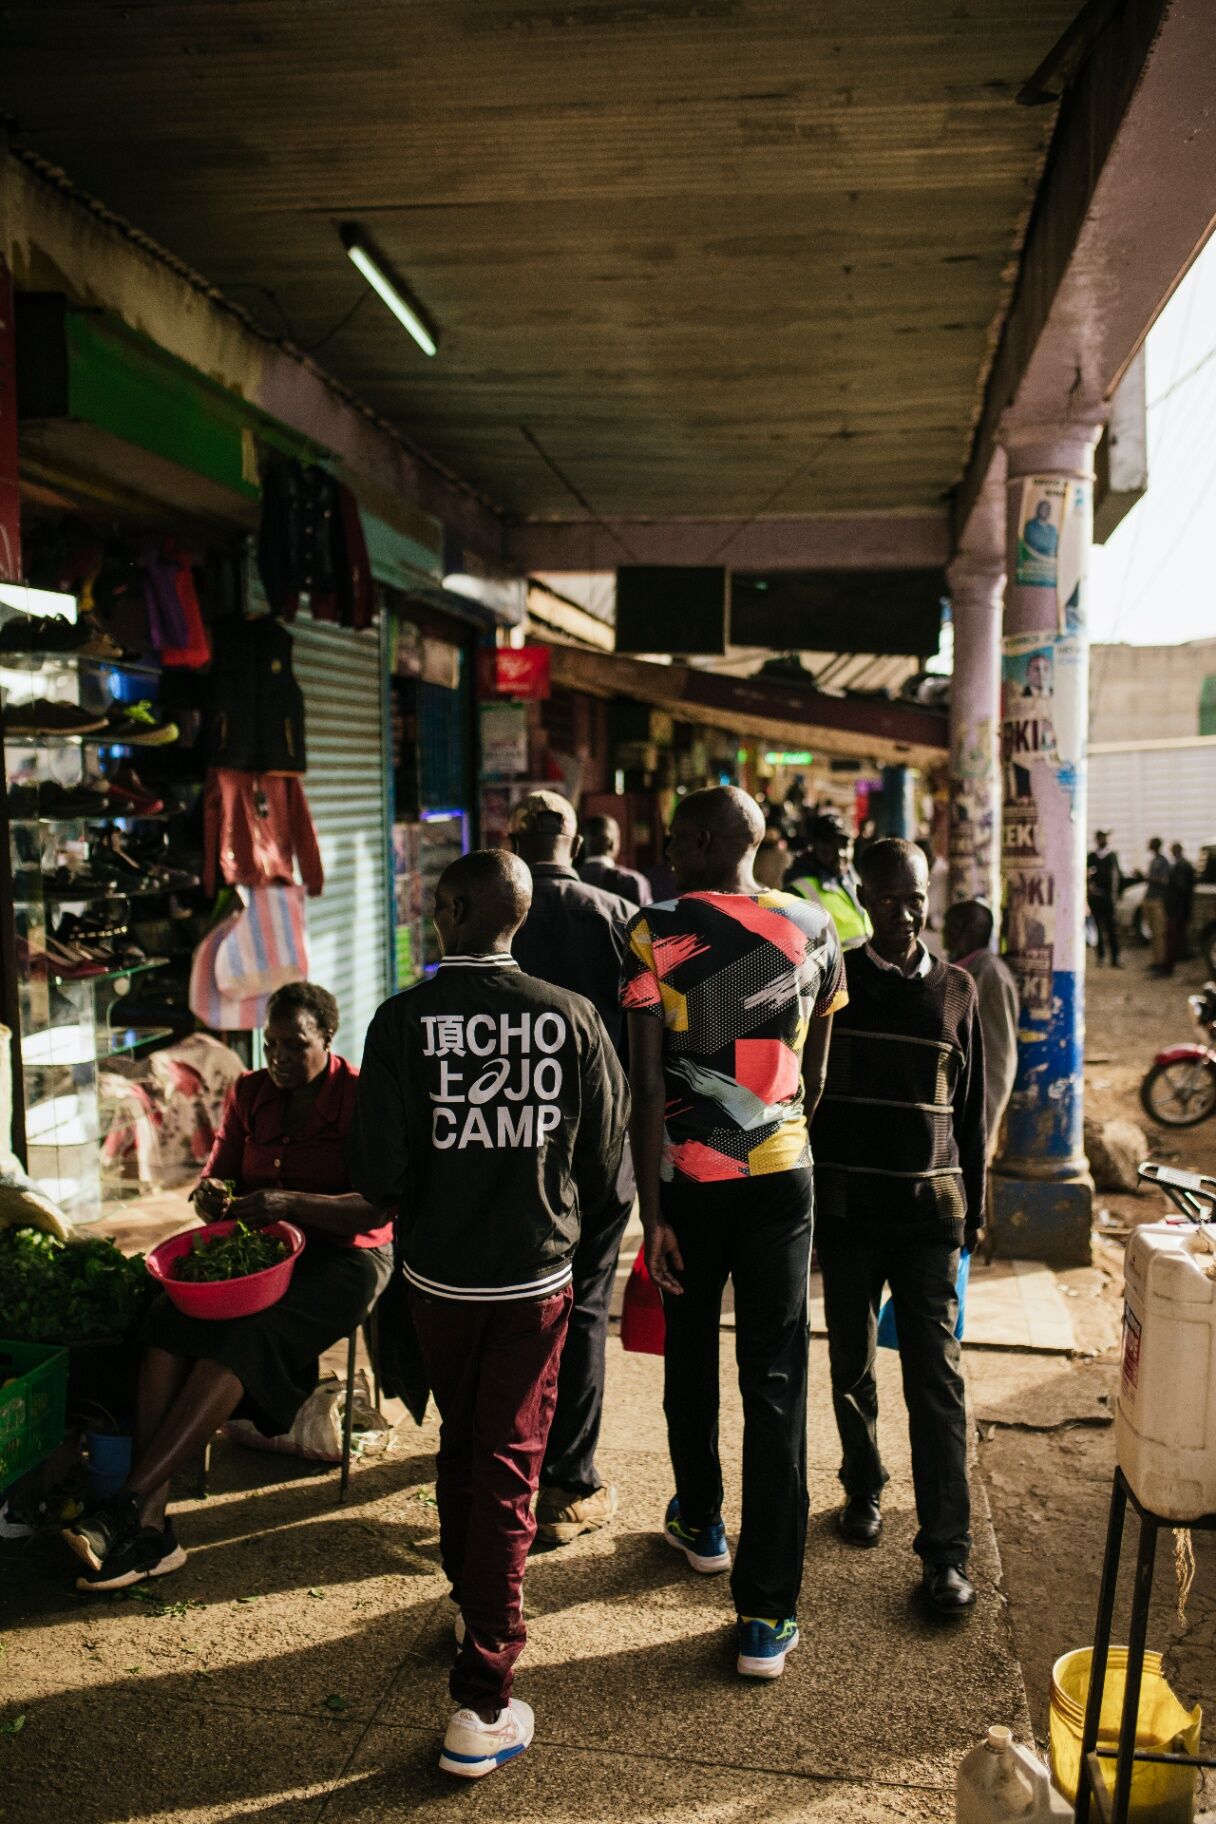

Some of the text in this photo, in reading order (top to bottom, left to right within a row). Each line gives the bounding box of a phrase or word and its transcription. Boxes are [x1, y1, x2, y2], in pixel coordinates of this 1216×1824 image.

[420, 1011, 566, 1058] 頂 CHO
[429, 1057, 563, 1103] 上 JO
[431, 1104, 562, 1150] CAMP
